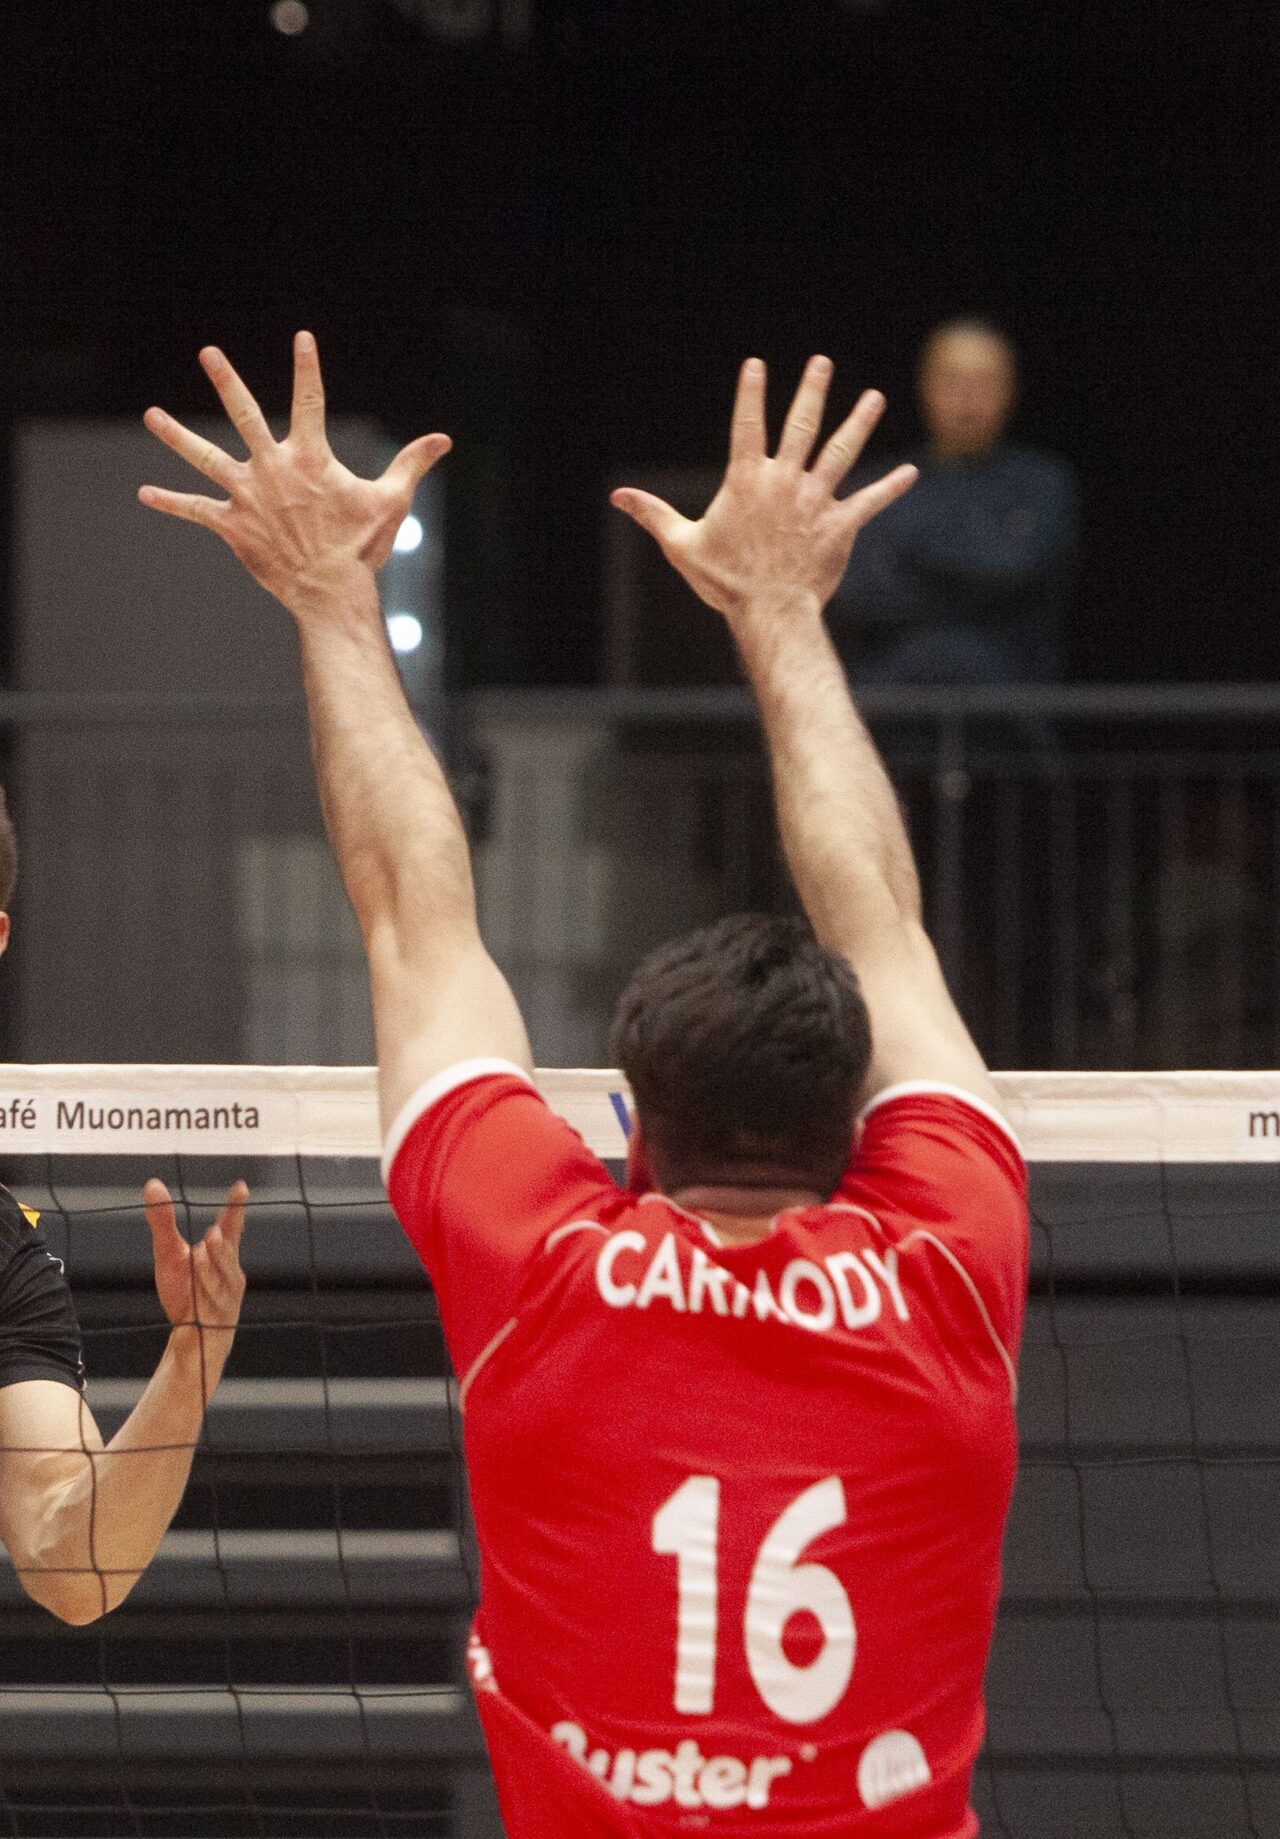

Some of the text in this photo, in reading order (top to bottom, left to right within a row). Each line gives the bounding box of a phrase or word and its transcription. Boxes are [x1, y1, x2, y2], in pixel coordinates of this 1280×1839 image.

[56, 1100, 261, 1131] Muonamanta
[595, 1230, 911, 1333] CARMODY
[651, 1475, 857, 1726] 16
